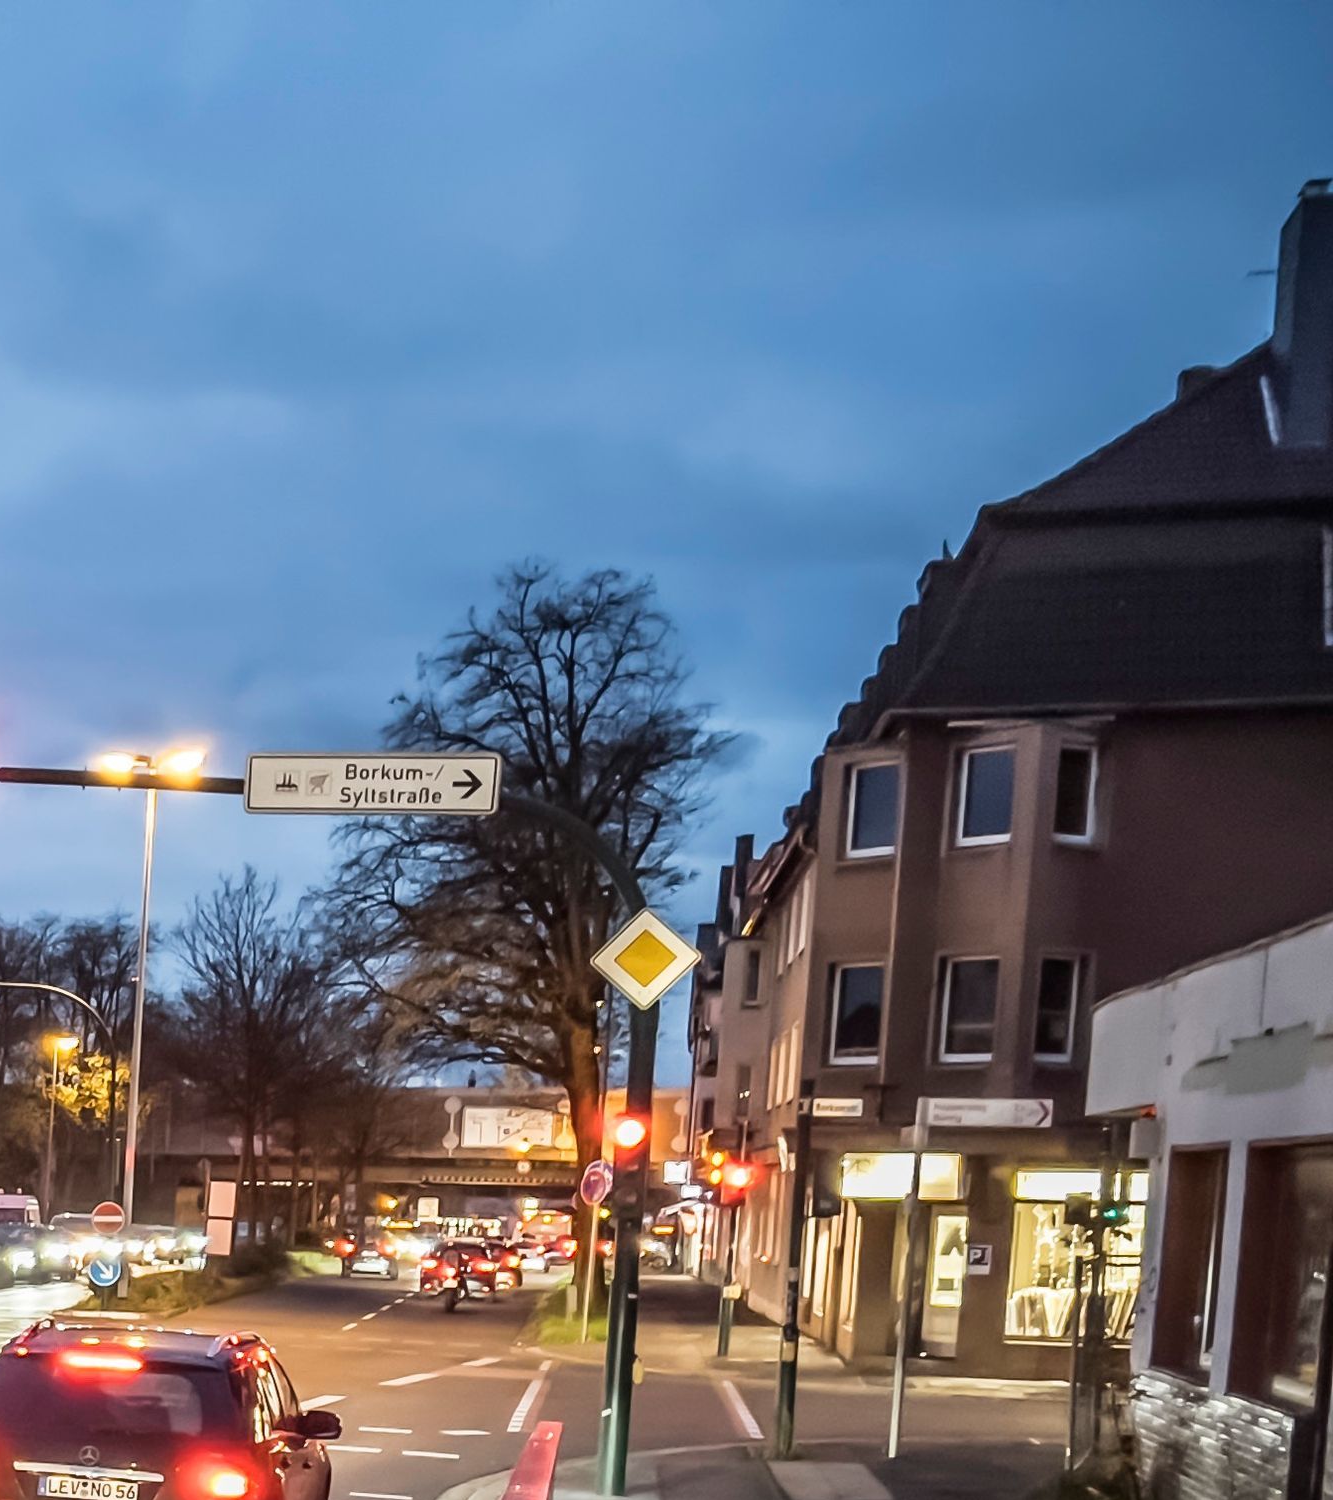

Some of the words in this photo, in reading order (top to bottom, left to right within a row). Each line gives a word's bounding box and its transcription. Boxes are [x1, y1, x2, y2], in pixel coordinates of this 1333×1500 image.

[345, 764, 445, 781] Borkum-/
[339, 787, 443, 808] Syltstraße
[48, 1478, 81, 1495] LEV
[115, 1485, 136, 1500] 56
